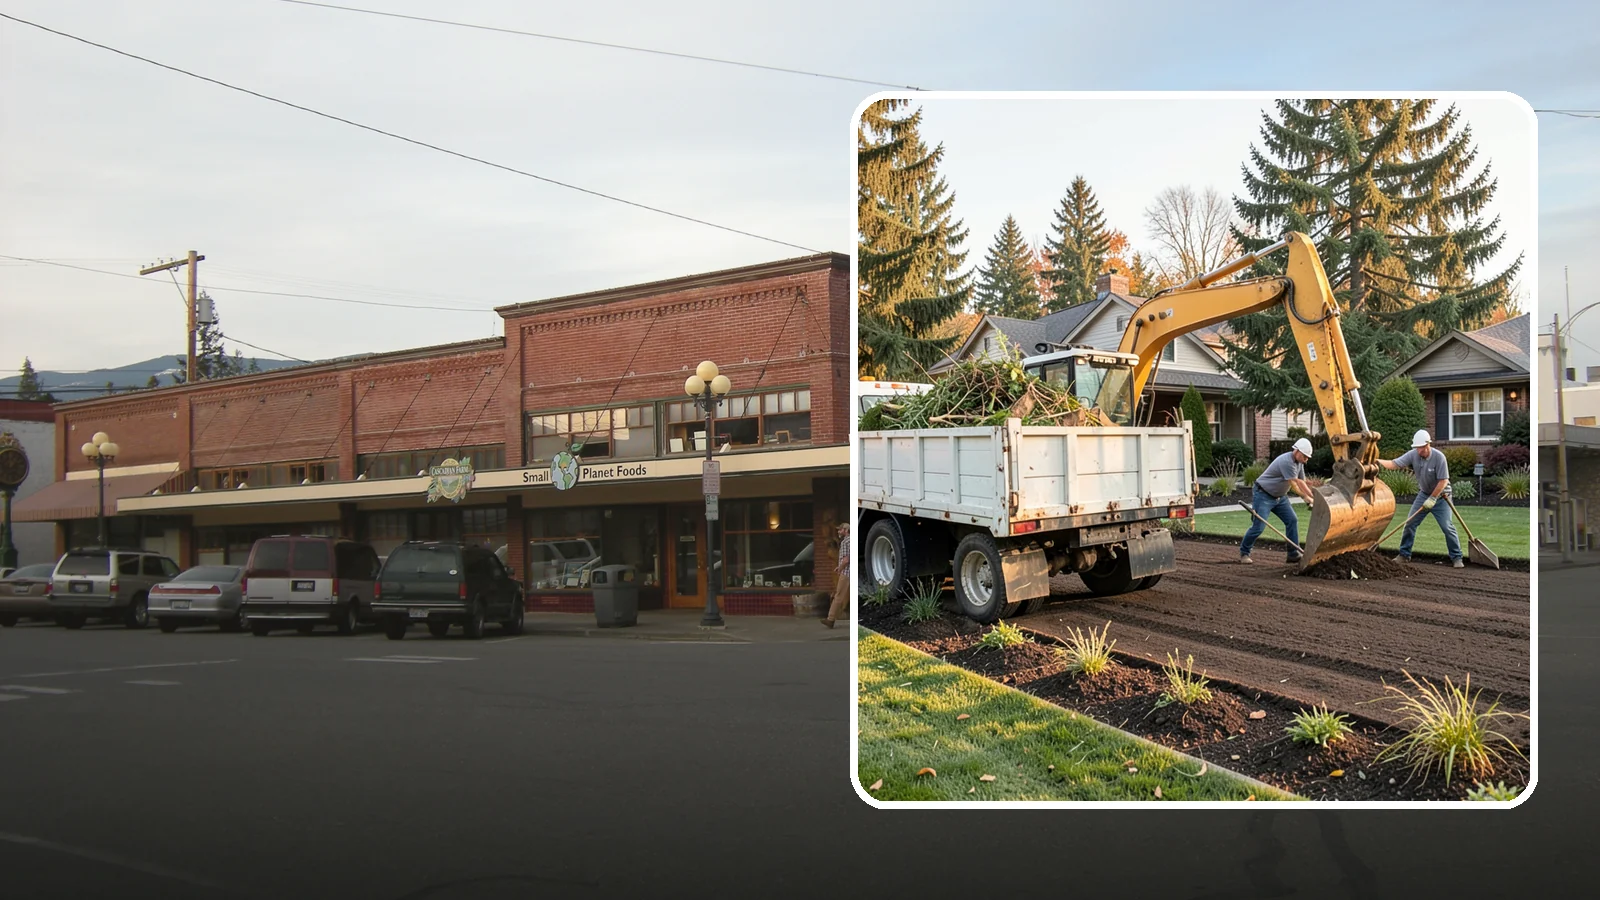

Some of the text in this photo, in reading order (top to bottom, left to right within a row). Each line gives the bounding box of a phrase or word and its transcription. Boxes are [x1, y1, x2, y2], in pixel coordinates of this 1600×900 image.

[523, 464, 647, 483] Small Planet Foods
